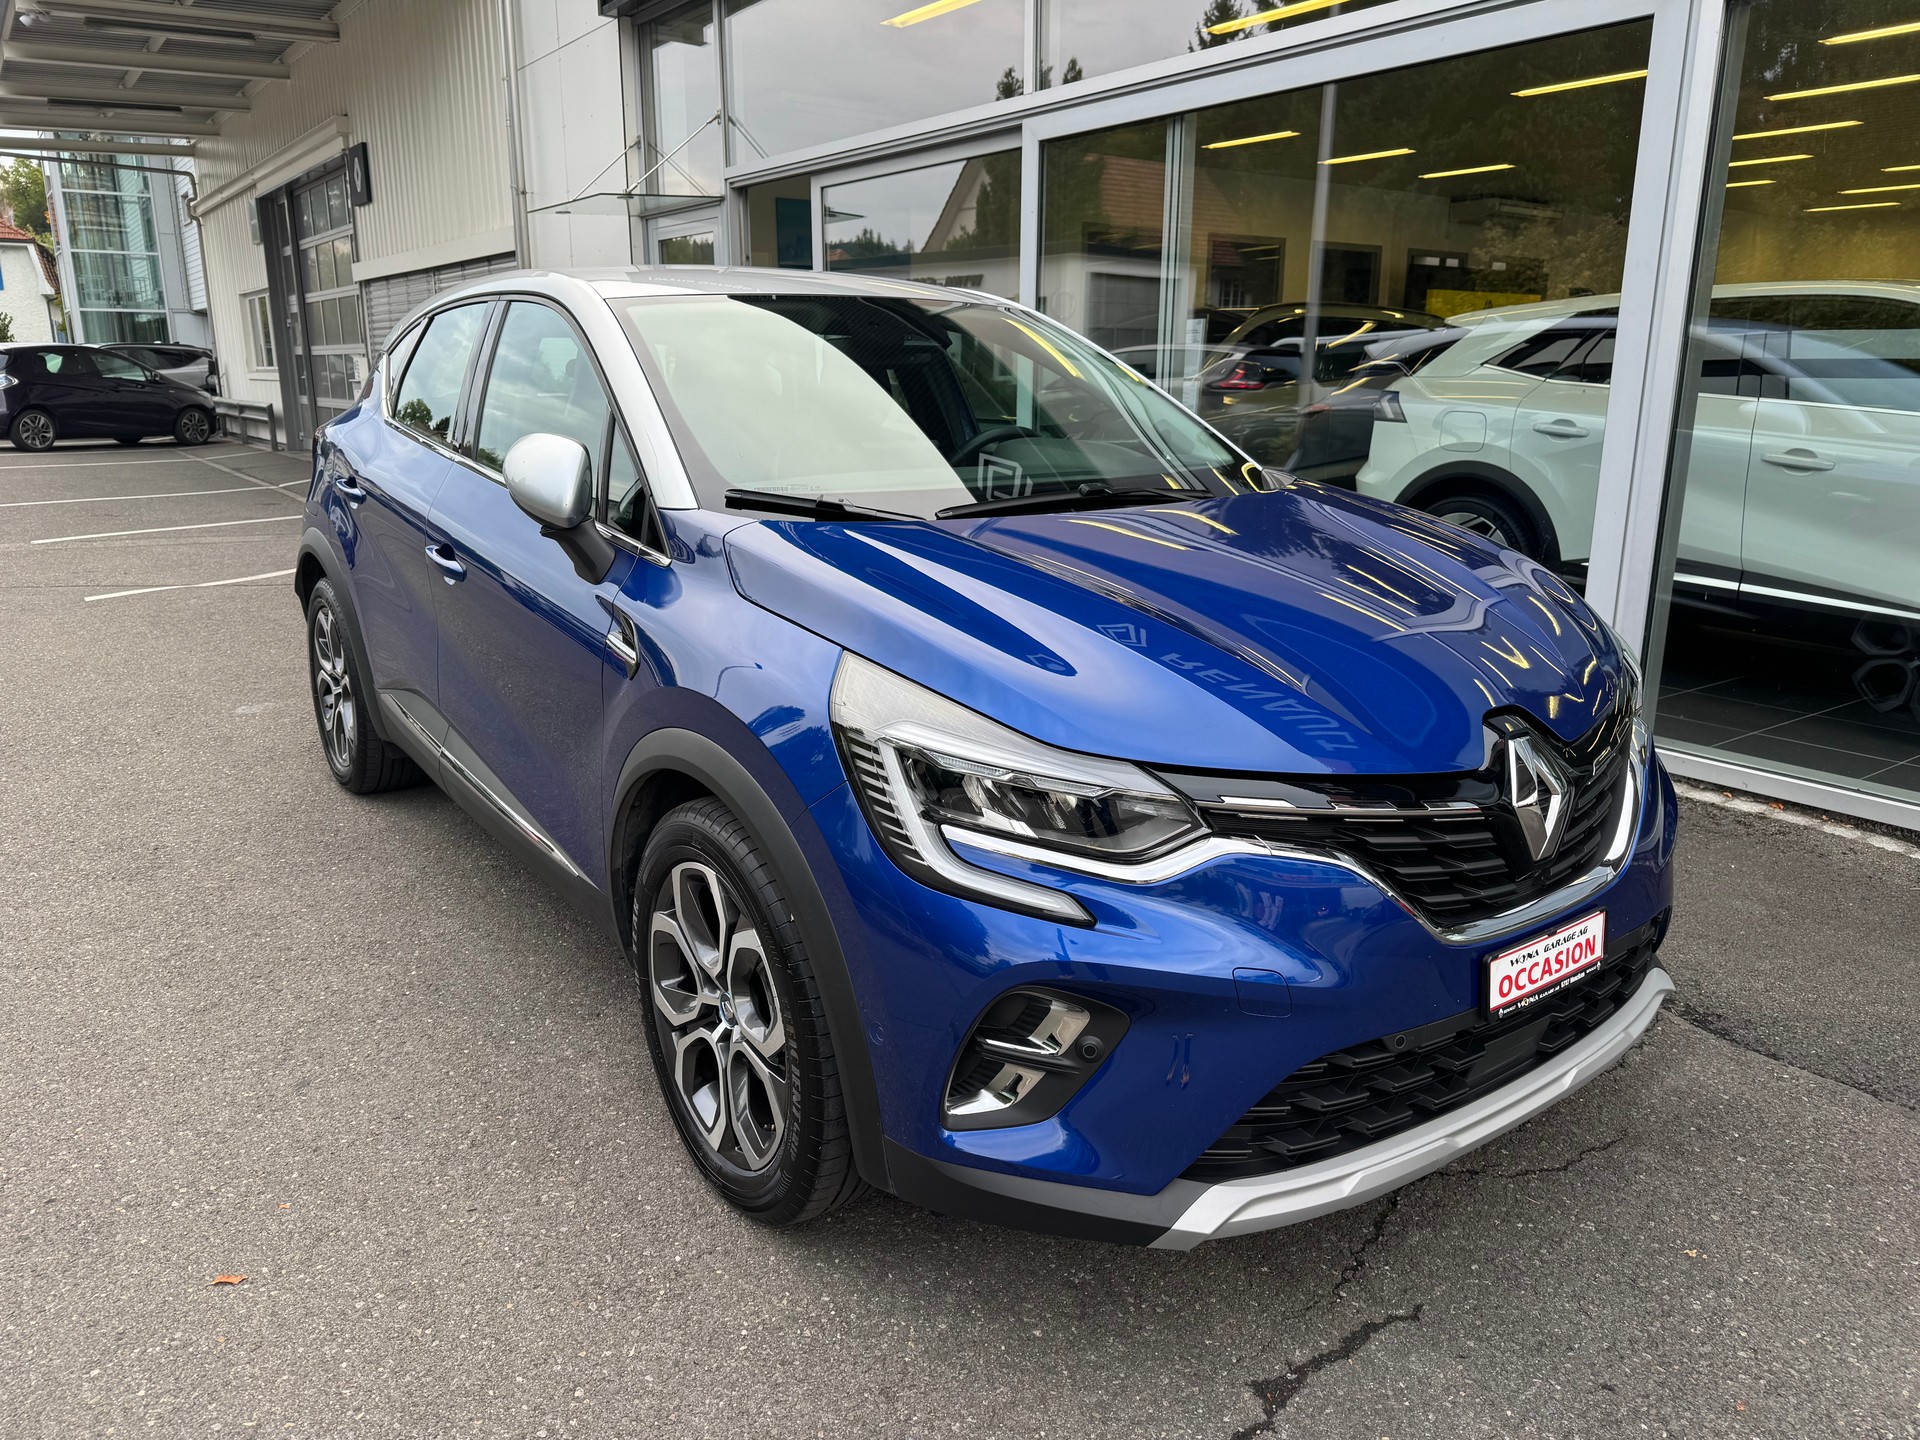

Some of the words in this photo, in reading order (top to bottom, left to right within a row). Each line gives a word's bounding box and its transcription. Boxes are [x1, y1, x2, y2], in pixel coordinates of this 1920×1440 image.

[1543, 931, 1576, 953] GARAGE
[1577, 926, 1588, 938] AG
[1498, 935, 1596, 998] OCCASION
